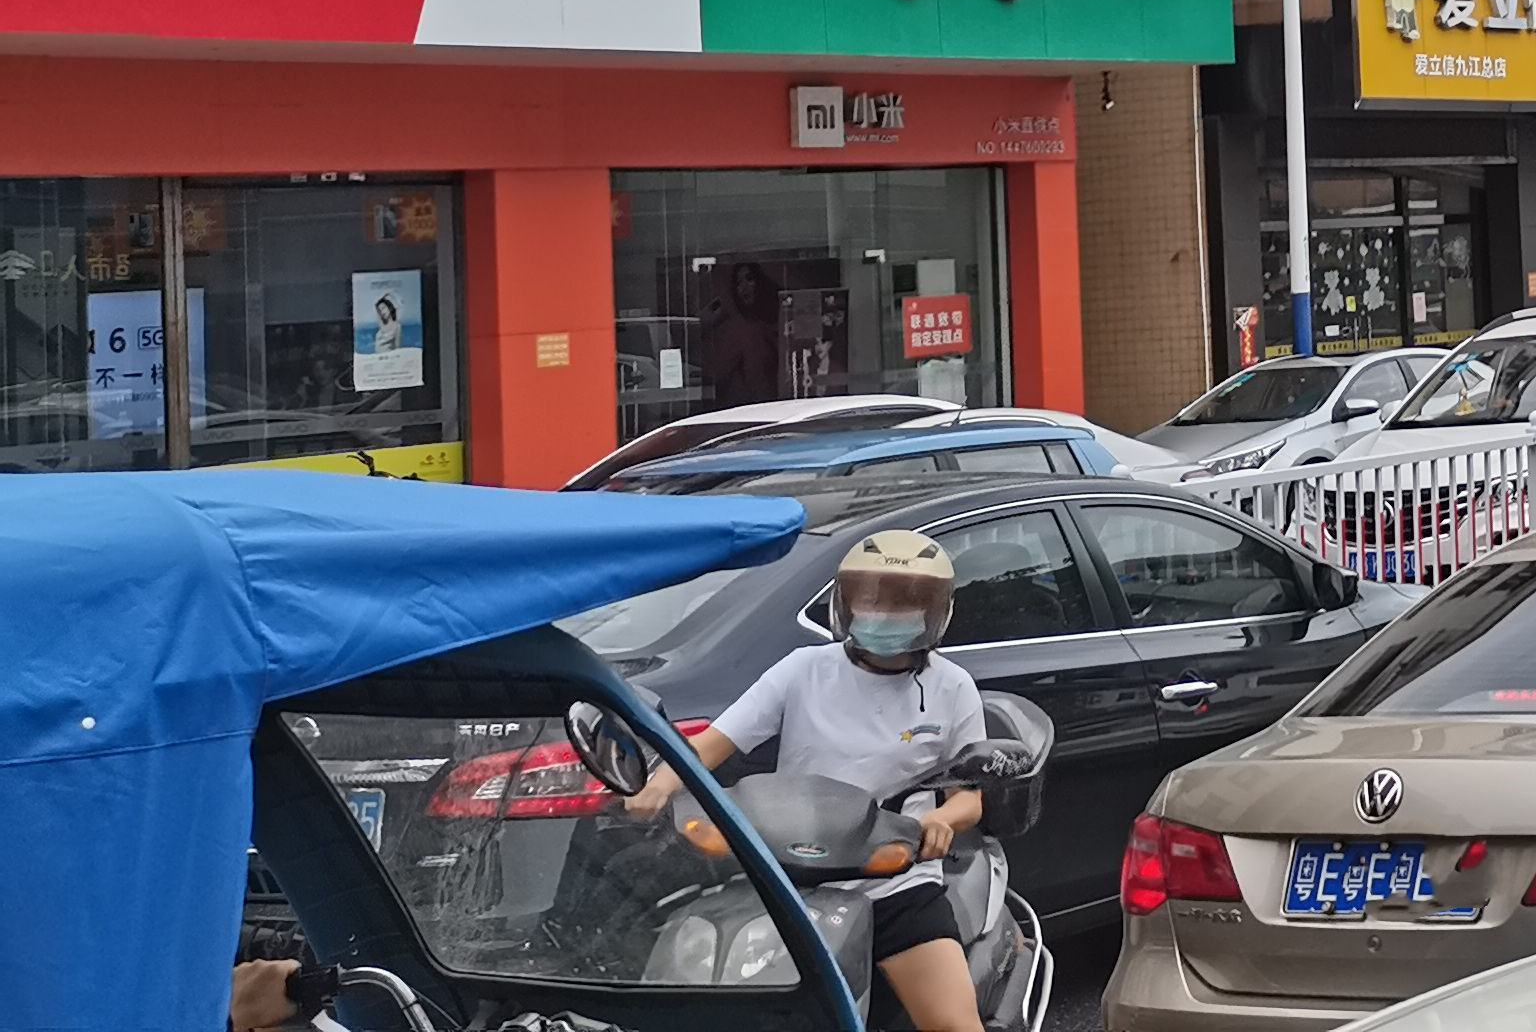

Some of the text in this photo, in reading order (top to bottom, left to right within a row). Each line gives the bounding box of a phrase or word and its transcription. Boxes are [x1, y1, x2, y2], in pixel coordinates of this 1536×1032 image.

[1414, 53, 1507, 79] 爱立信九江总店
[852, 92, 905, 130] 小米
